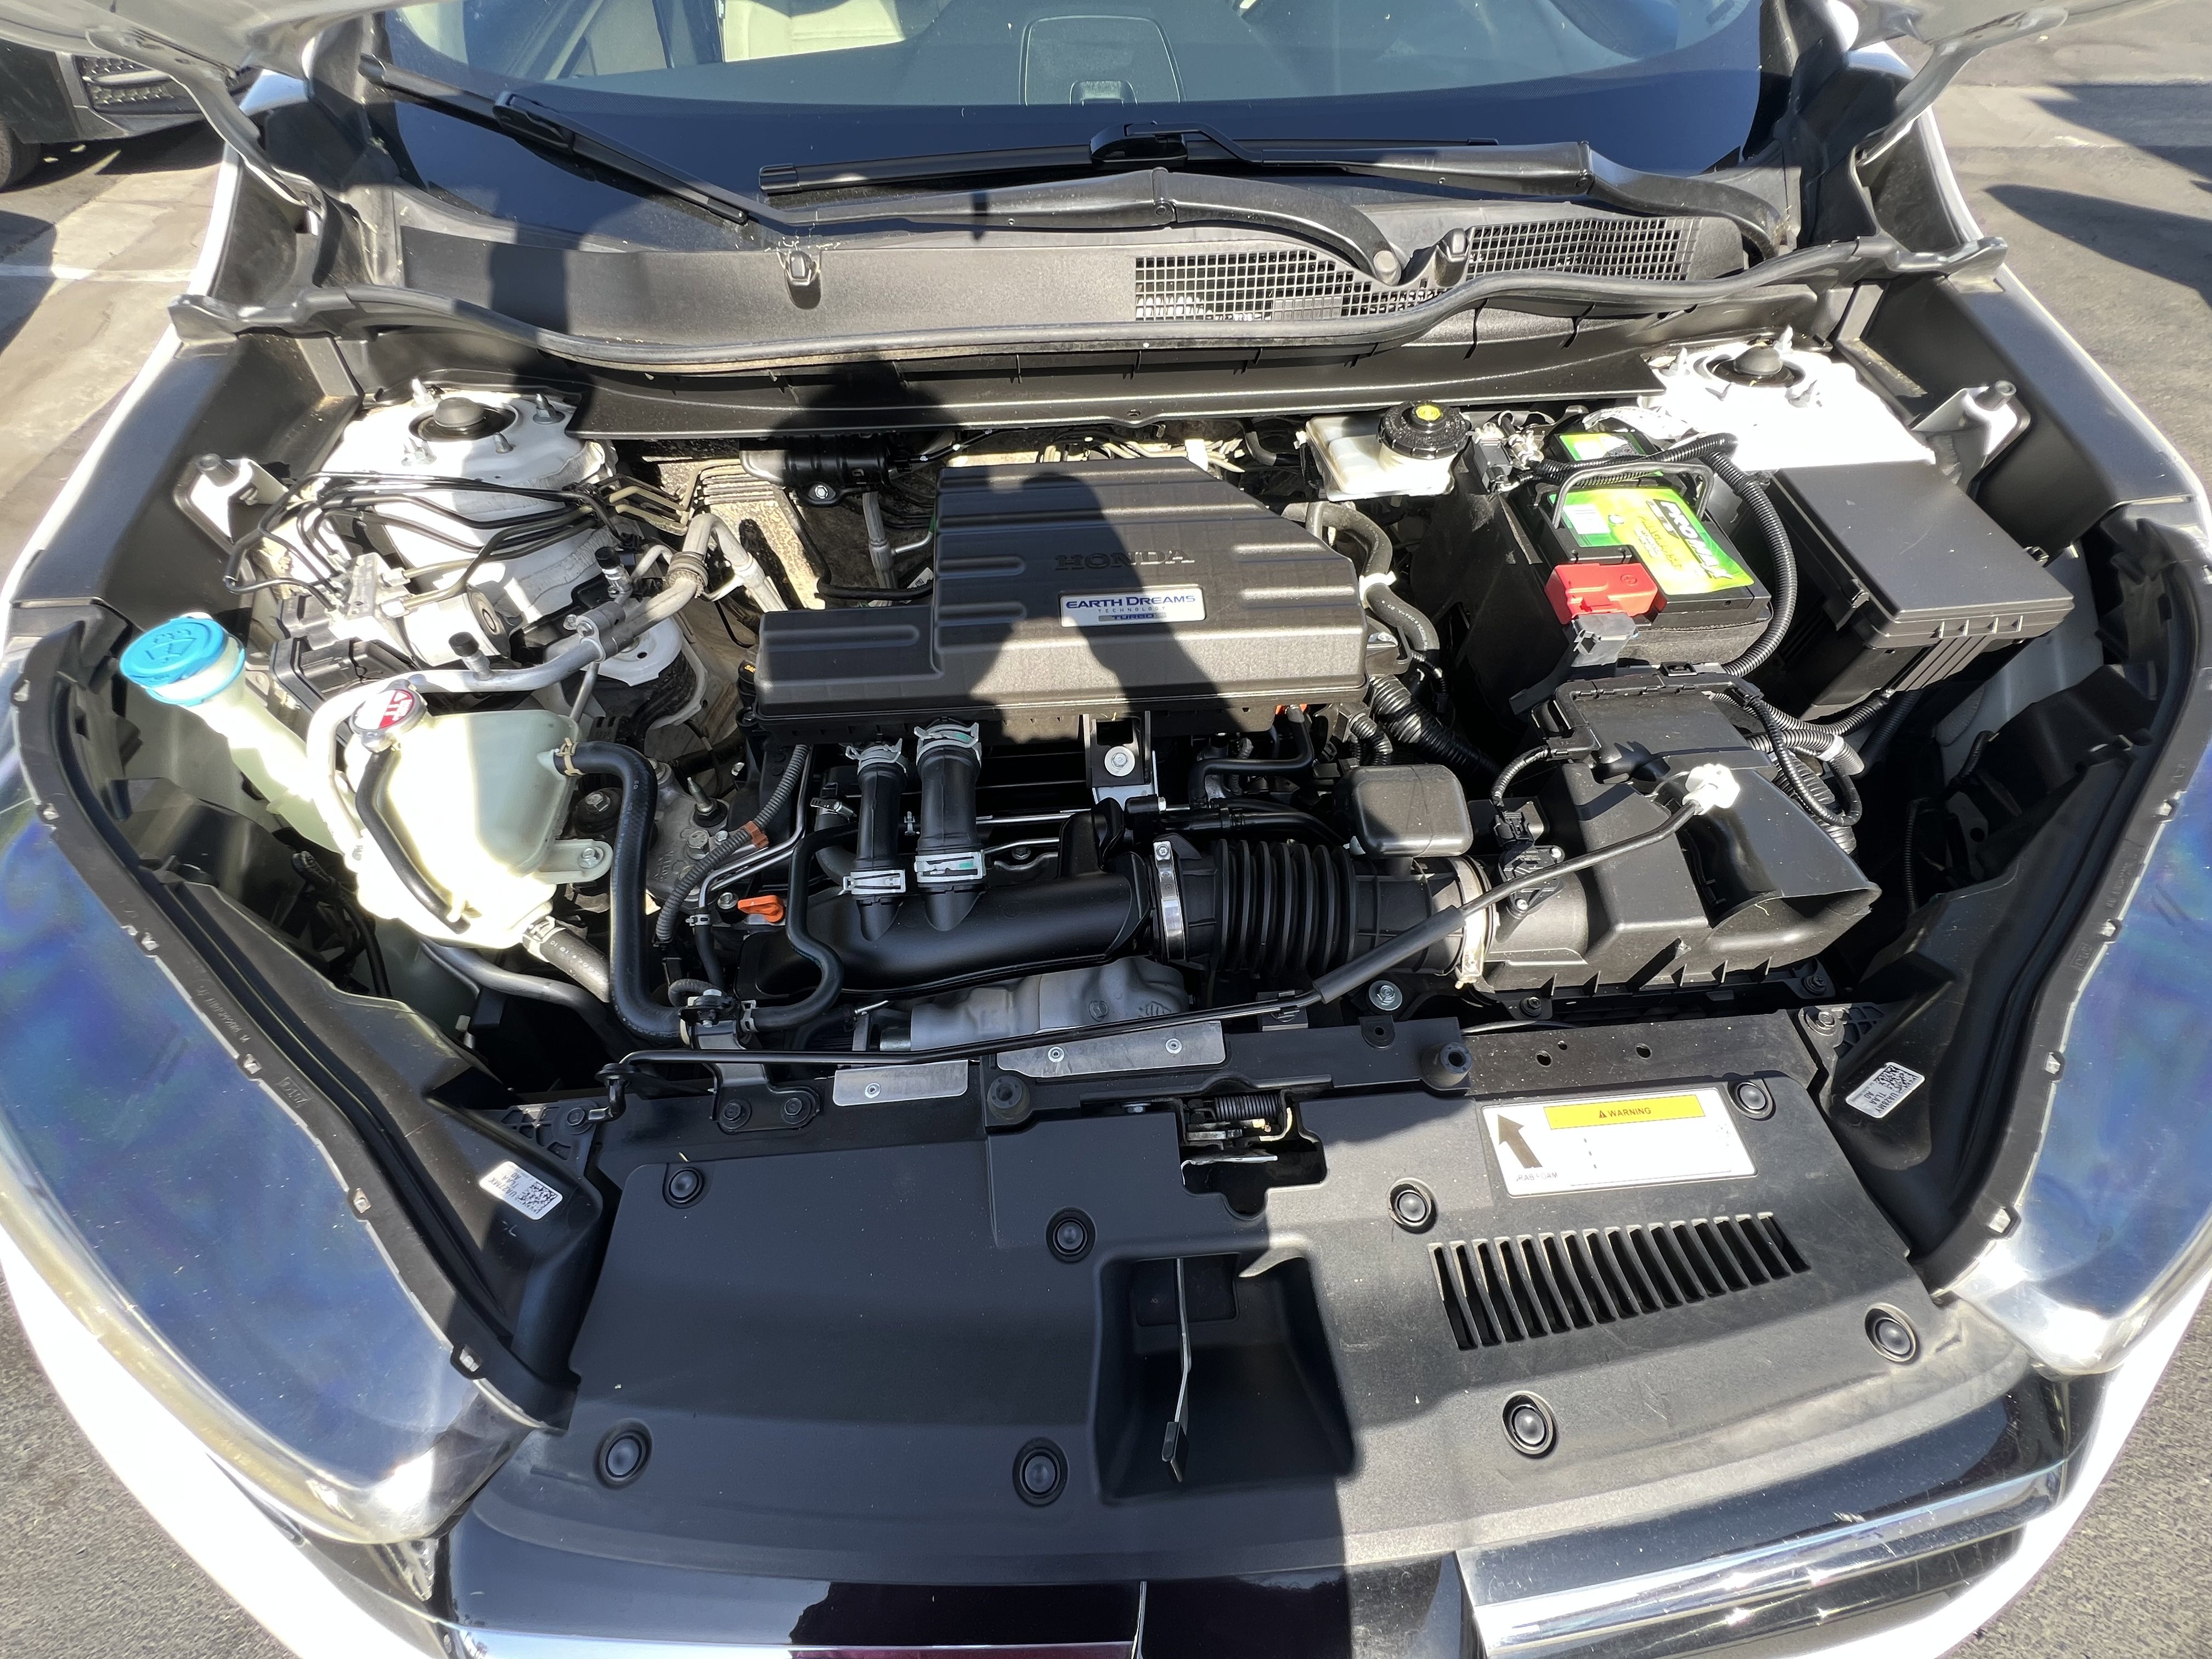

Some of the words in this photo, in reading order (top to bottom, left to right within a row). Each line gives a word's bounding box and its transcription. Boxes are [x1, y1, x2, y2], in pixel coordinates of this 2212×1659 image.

[1660, 500, 1733, 580] PROMAX
[1055, 549, 1195, 571] HONDA
[1066, 599, 1122, 609] EARTH
[1126, 595, 1196, 606] DREAMS
[1869, 1092, 1887, 1105] TLAA
[1607, 1107, 1652, 1118] WARNING
